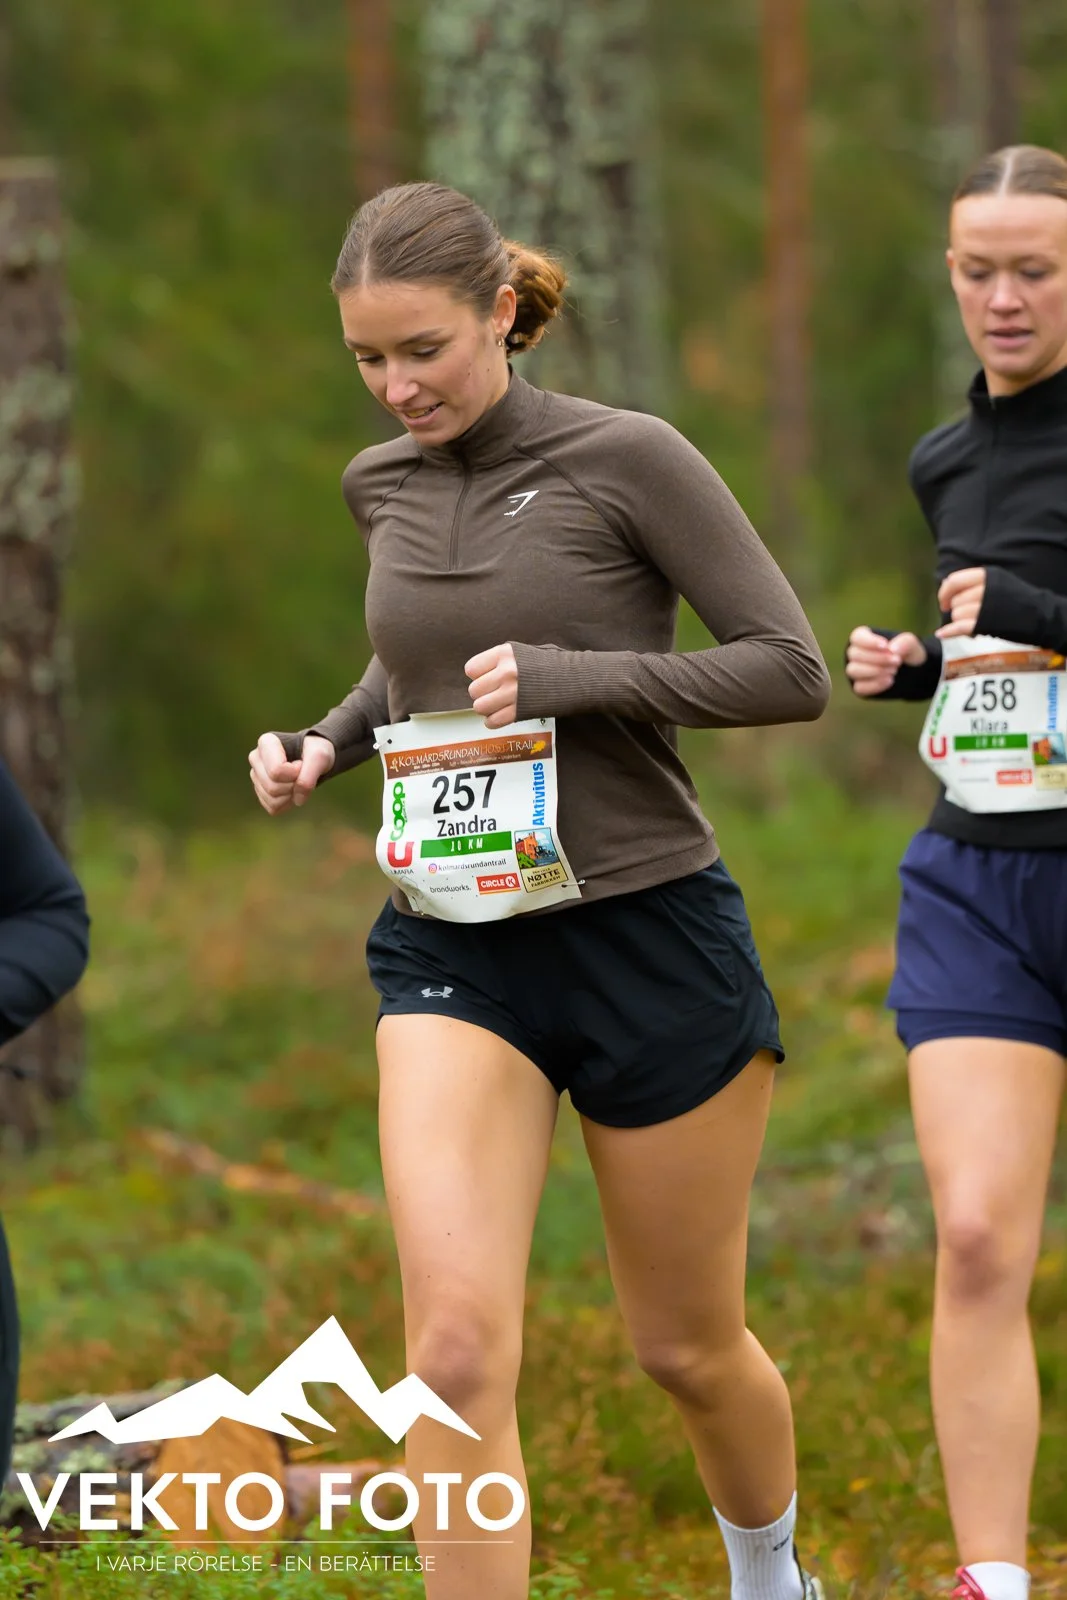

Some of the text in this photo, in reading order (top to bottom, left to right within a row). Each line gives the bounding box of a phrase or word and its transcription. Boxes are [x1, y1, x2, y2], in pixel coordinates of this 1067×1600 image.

[963, 679, 1017, 713] 258
[970, 717, 1009, 734] Klara
[431, 769, 497, 815] 257
[532, 762, 545, 826] Aktivitus
[437, 815, 497, 838] Zandra
[480, 878, 505, 888] CIRCLE
